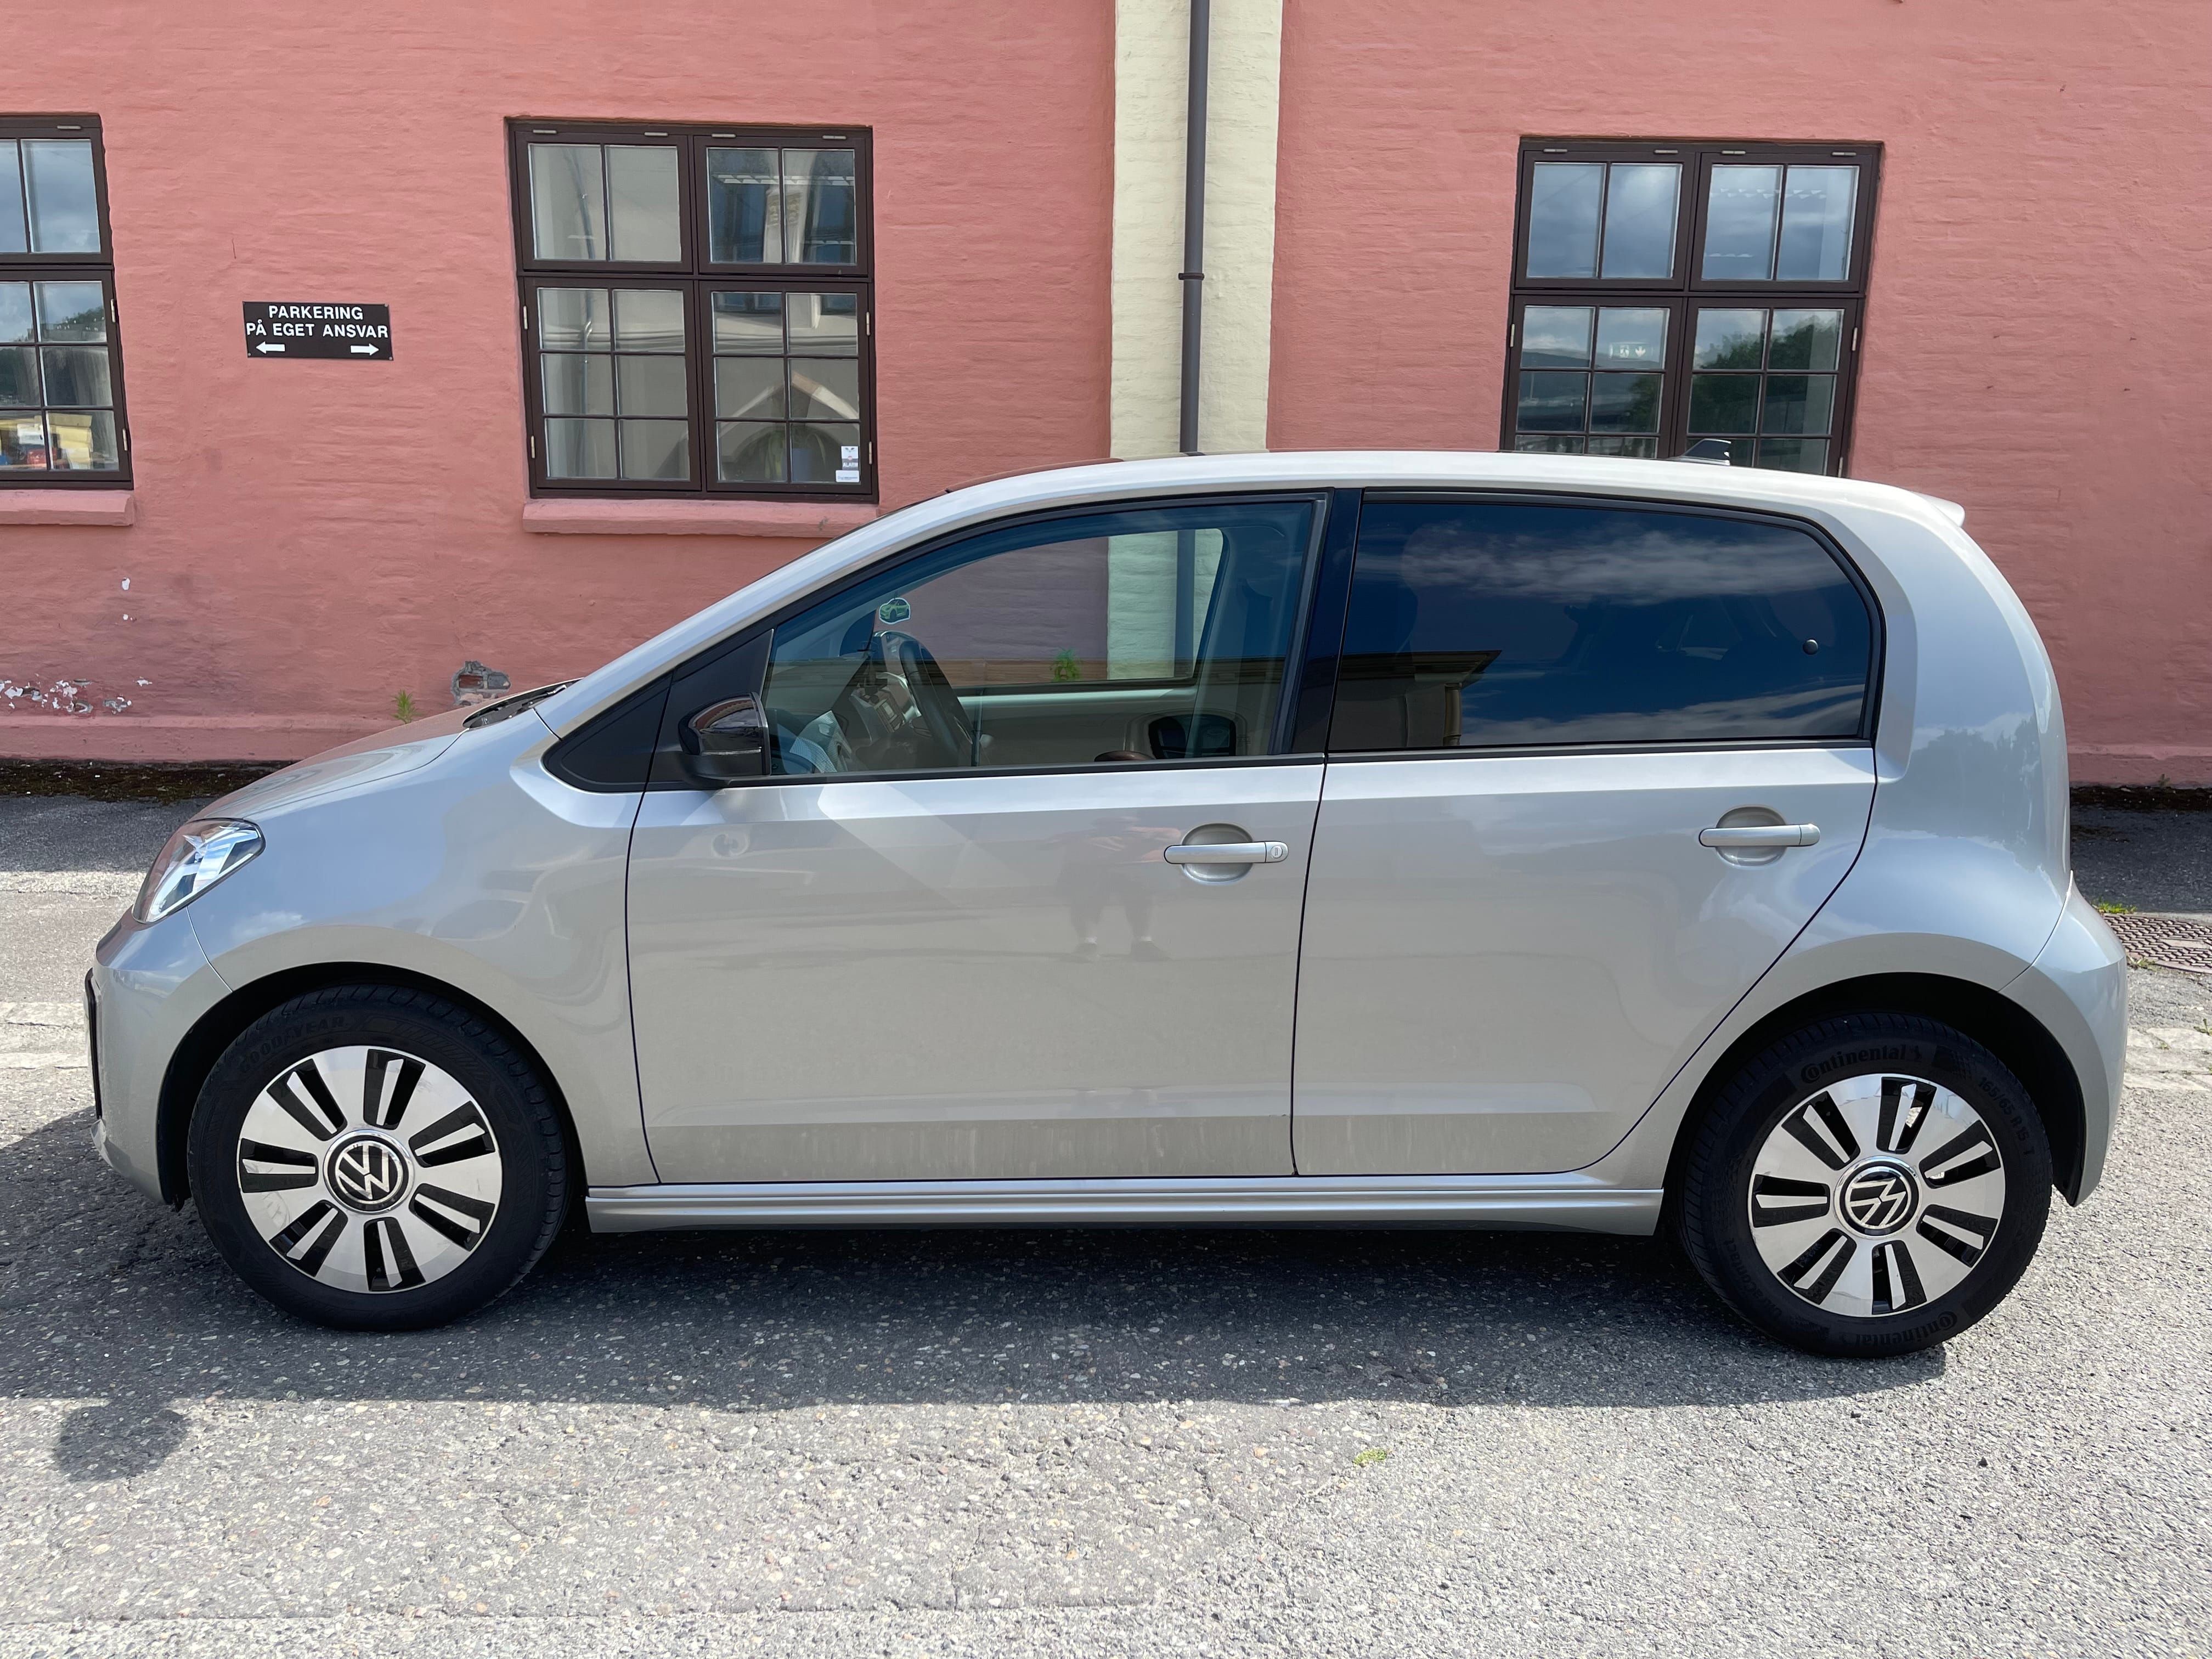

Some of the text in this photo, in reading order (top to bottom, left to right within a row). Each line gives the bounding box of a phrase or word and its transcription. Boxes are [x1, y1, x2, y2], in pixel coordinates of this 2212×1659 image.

[269, 306, 363, 320] PARKERING
[246, 319, 388, 338] PÅ EGET ANSVAR
[1800, 1043, 1906, 1084] Continental
[1977, 1076, 2016, 1115] 165/65
